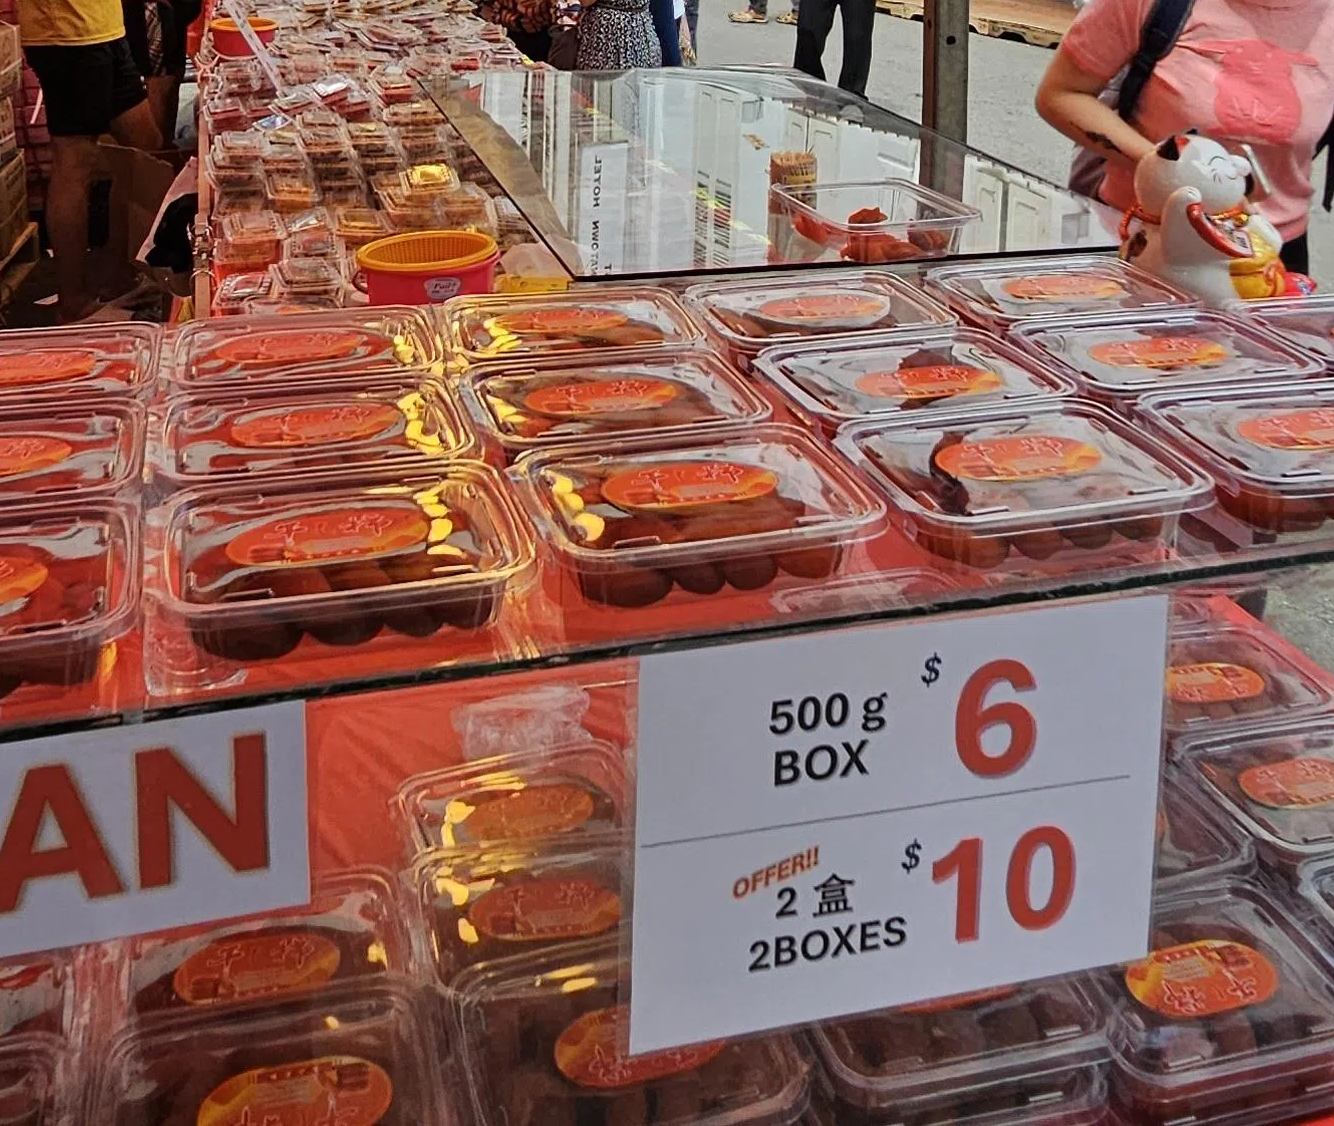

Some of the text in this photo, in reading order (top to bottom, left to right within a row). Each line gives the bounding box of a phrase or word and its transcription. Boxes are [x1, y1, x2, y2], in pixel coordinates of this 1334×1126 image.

[769, 692, 850, 735] 500
[862, 692, 889, 731] g
[773, 740, 870, 786] BOX
[731, 846, 820, 900] OFFER!!
[775, 873, 855, 918] 2 盒
[747, 915, 908, 972] 2BOXES
